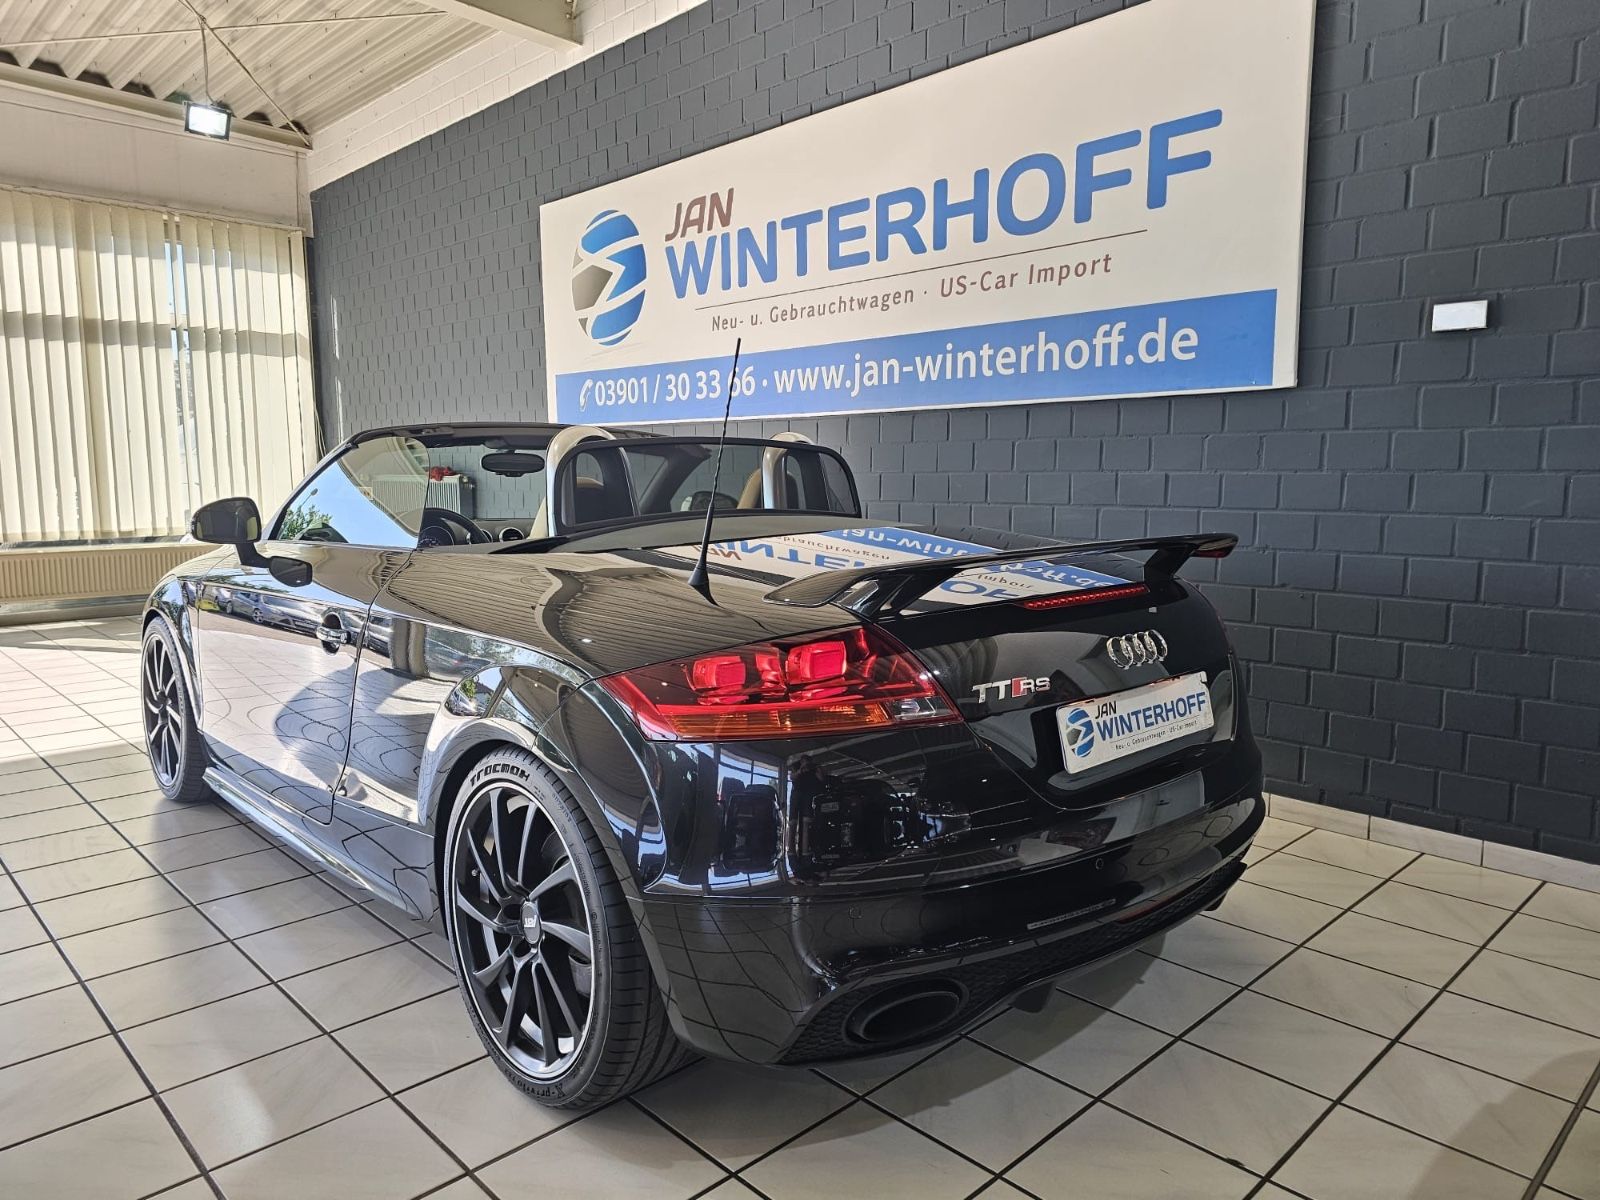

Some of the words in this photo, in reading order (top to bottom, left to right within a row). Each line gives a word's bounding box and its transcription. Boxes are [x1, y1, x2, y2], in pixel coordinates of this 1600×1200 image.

[664, 187, 735, 242] JAN
[665, 108, 1223, 299] WINTERHOFF
[711, 315, 744, 332] Neu-
[750, 313, 763, 327] u.
[769, 288, 914, 324] Gebrauchtwagen
[939, 270, 1019, 299] US-Car
[1027, 253, 1113, 286] Import
[665, 371, 691, 403] 30
[695, 368, 722, 400] 33
[773, 317, 1200, 398] www.jan-winterhoff.de
[1095, 700, 1117, 720] JAN
[1096, 691, 1206, 741] WINTERHOFF
